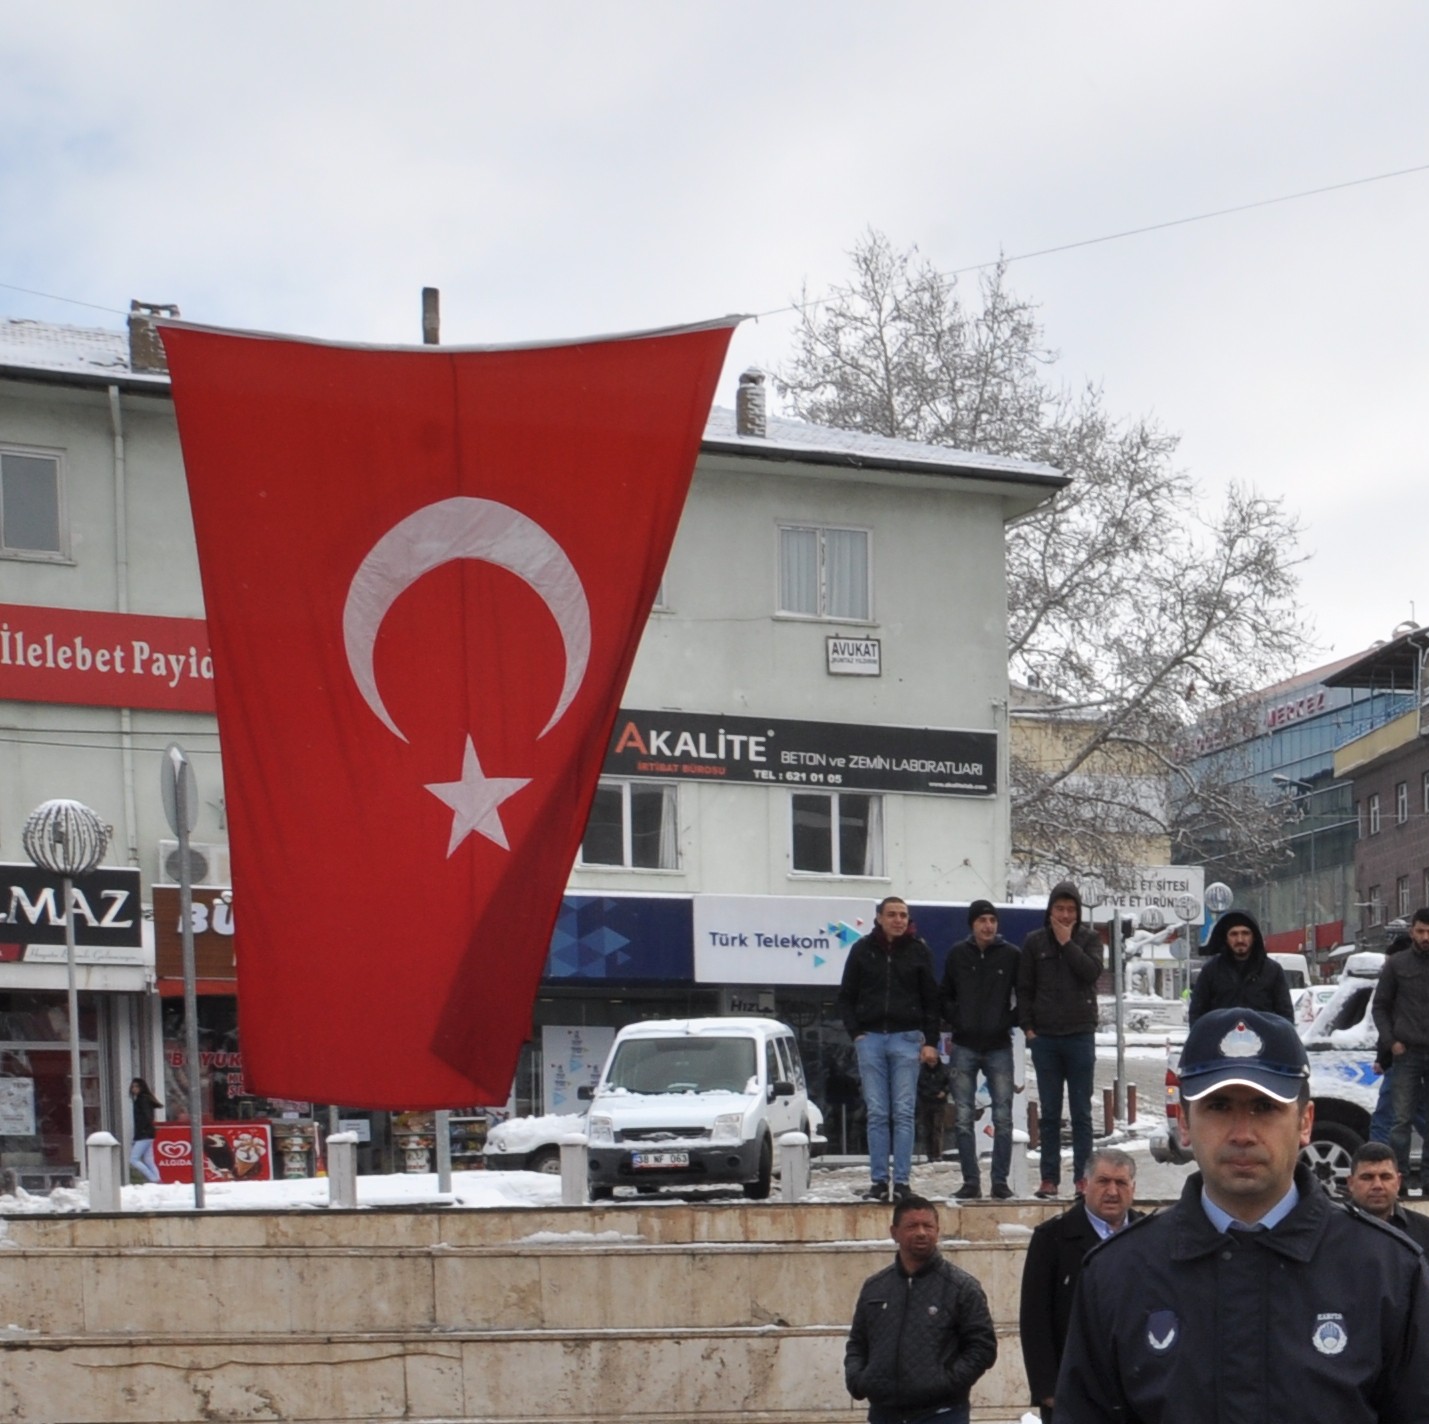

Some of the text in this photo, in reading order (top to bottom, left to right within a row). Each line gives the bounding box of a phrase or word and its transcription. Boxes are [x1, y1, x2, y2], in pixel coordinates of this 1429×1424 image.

[0, 623, 125, 674] İlelebet
[832, 642, 876, 657] AVUKAT
[615, 721, 767, 762] AKALİTE
[780, 750, 983, 776] BETON ve ZEMİN LABORATUARI
[753, 769, 777, 780] TEL
[785, 771, 807, 782] 621
[810, 773, 824, 783] 01
[827, 774, 842, 784] 05
[1113, 895, 1126, 908] VE
[1129, 896, 1142, 908] ET
[709, 932, 830, 949] Türk Telekom
